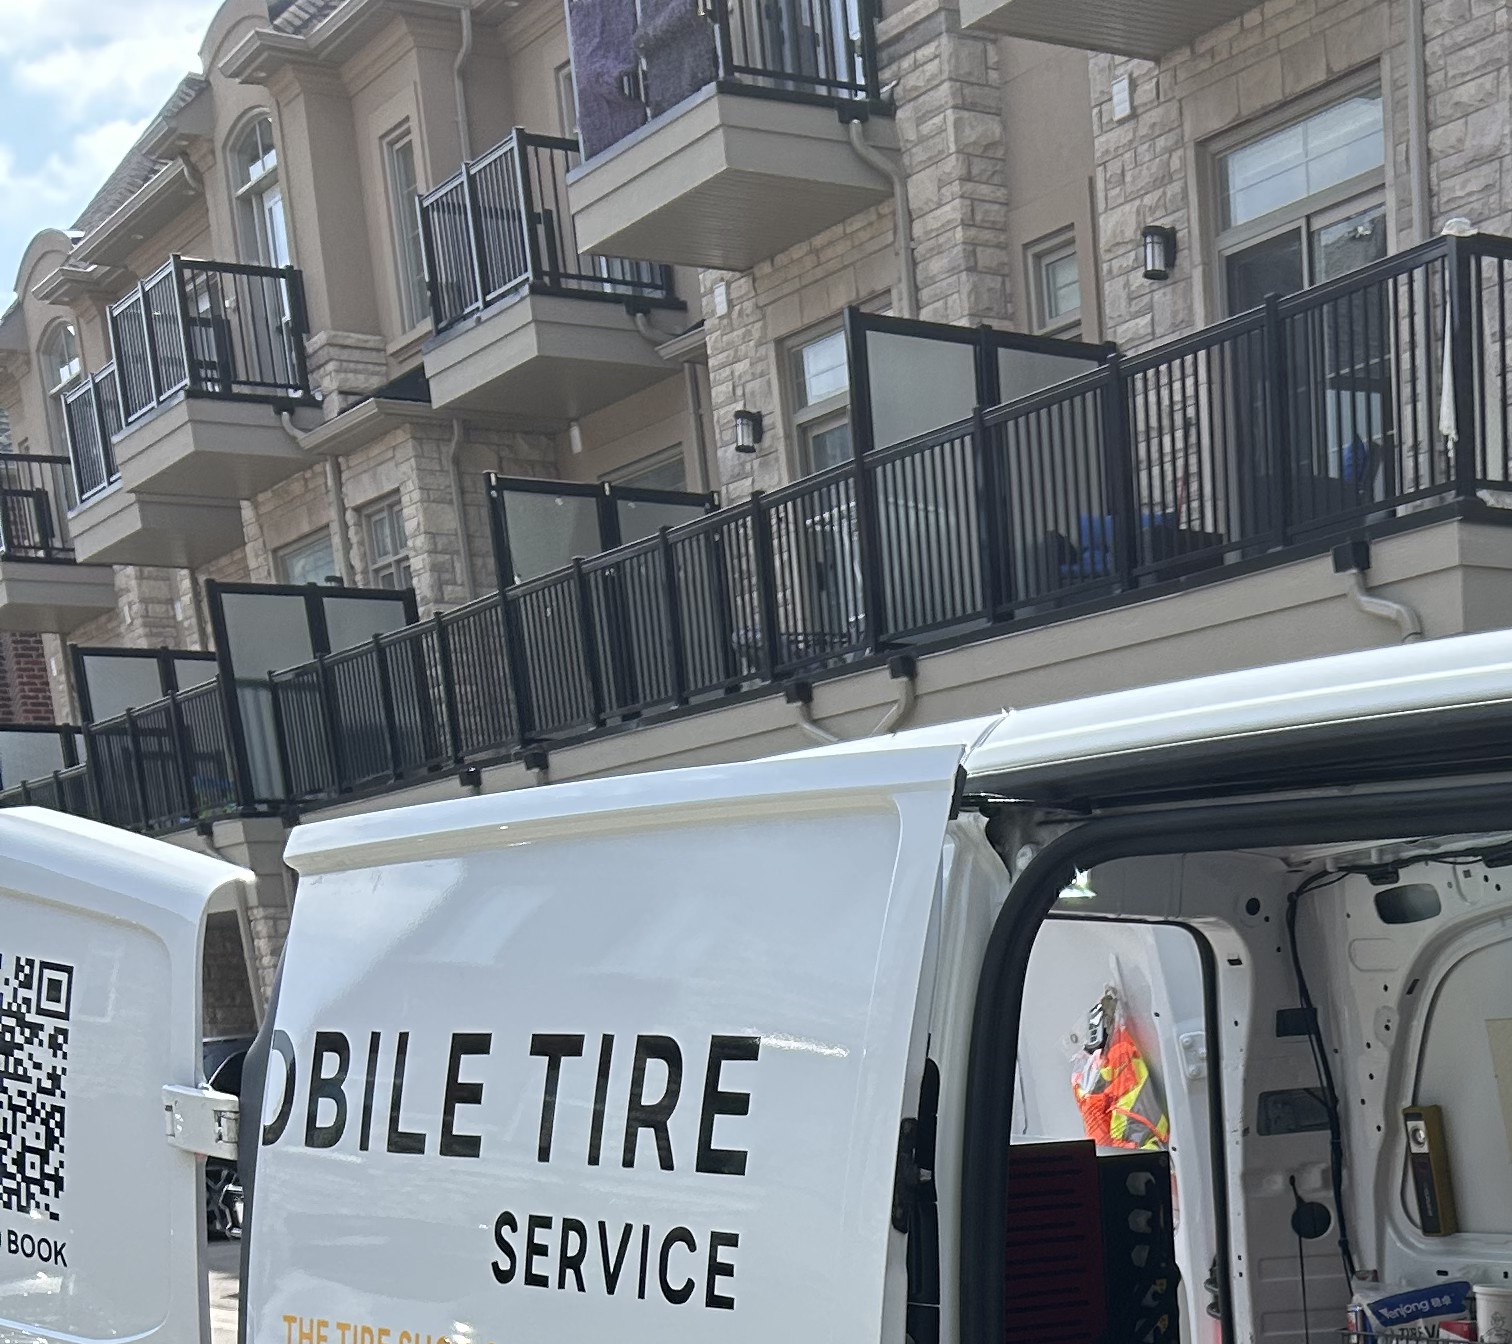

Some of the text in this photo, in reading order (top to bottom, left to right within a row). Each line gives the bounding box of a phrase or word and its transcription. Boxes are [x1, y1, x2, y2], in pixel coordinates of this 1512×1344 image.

[529, 1033, 762, 1177] TIRE
[7, 1229, 68, 1268] BOOK
[491, 1211, 740, 1311] SERVICE
